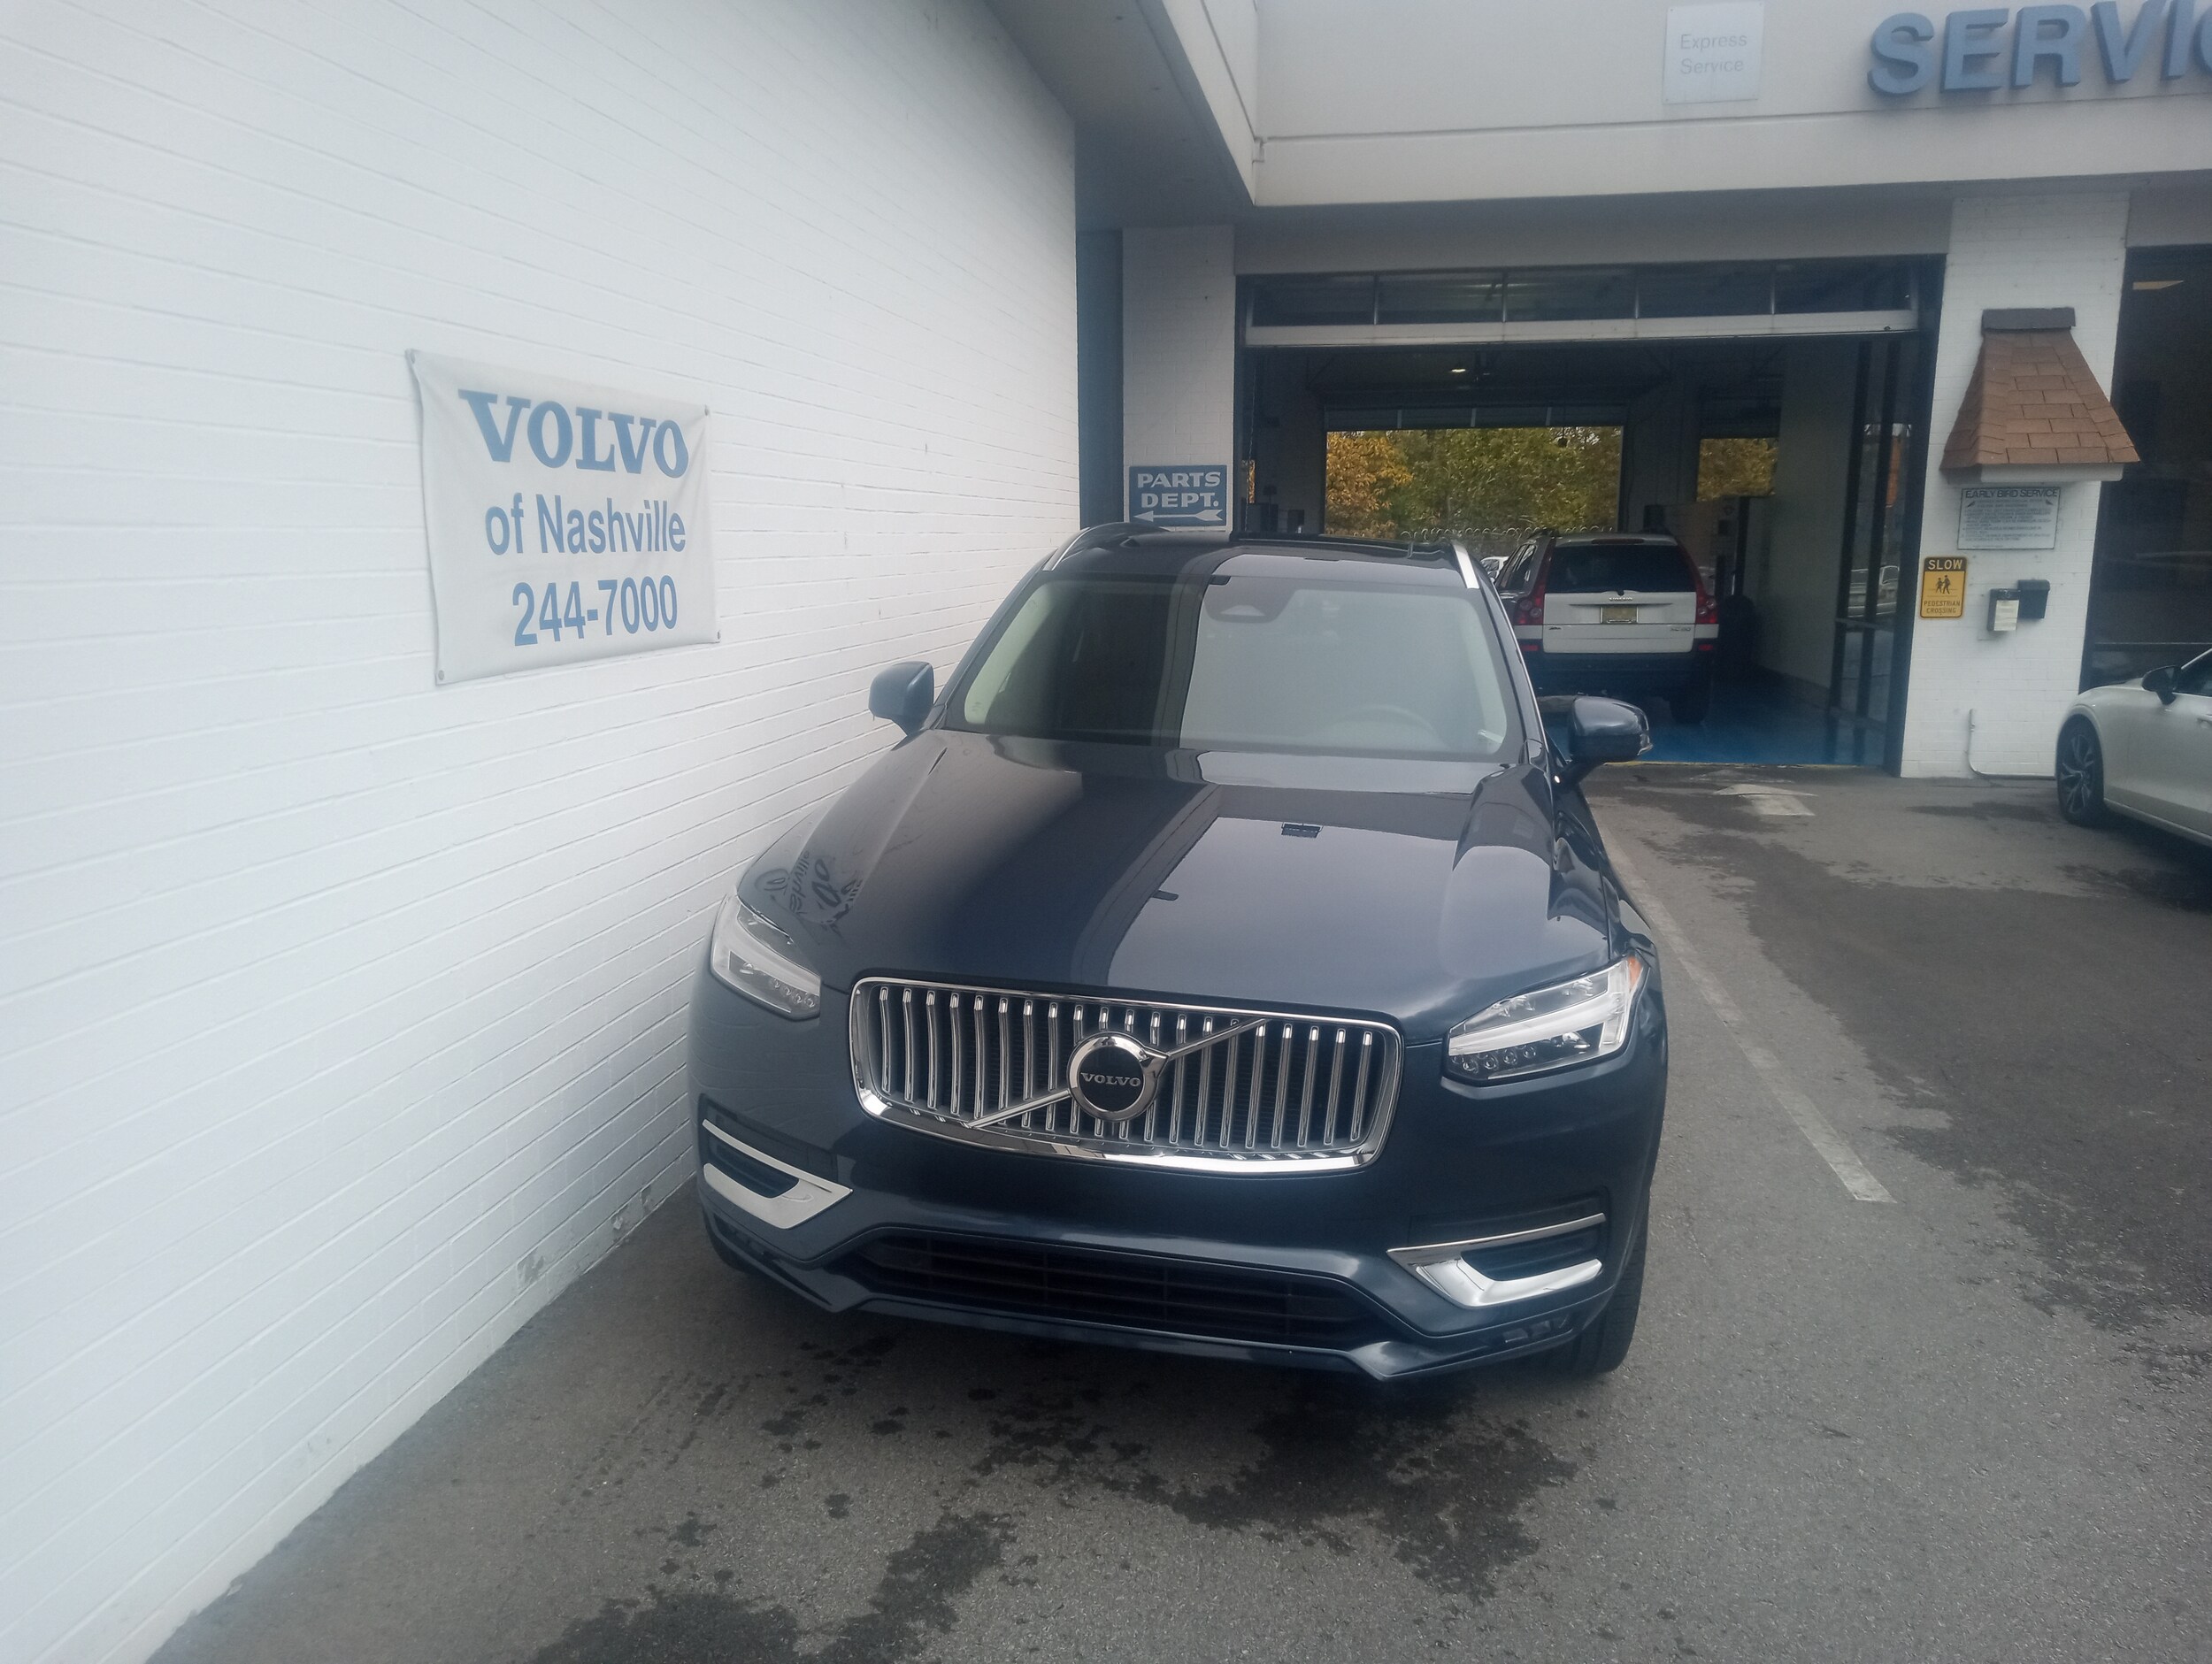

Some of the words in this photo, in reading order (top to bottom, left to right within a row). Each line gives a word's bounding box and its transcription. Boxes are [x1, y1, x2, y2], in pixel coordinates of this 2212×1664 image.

[1680, 34, 1747, 52] Express
[1867, 0, 2212, 96] SERVI
[1680, 58, 1744, 74] Service
[458, 389, 689, 479] VOLVO
[1137, 472, 1221, 488] PARTS
[1141, 492, 1219, 508] DEPT.
[1965, 489, 1996, 498] EARLY
[1997, 489, 2018, 498] BIRD
[2019, 488, 2058, 497] SERVICE
[485, 493, 524, 556] of
[535, 494, 687, 555] Nashville
[1928, 559, 1962, 570] SLOW
[512, 575, 678, 647] 244-7000
[1080, 1072, 1141, 1087] VOLVO
